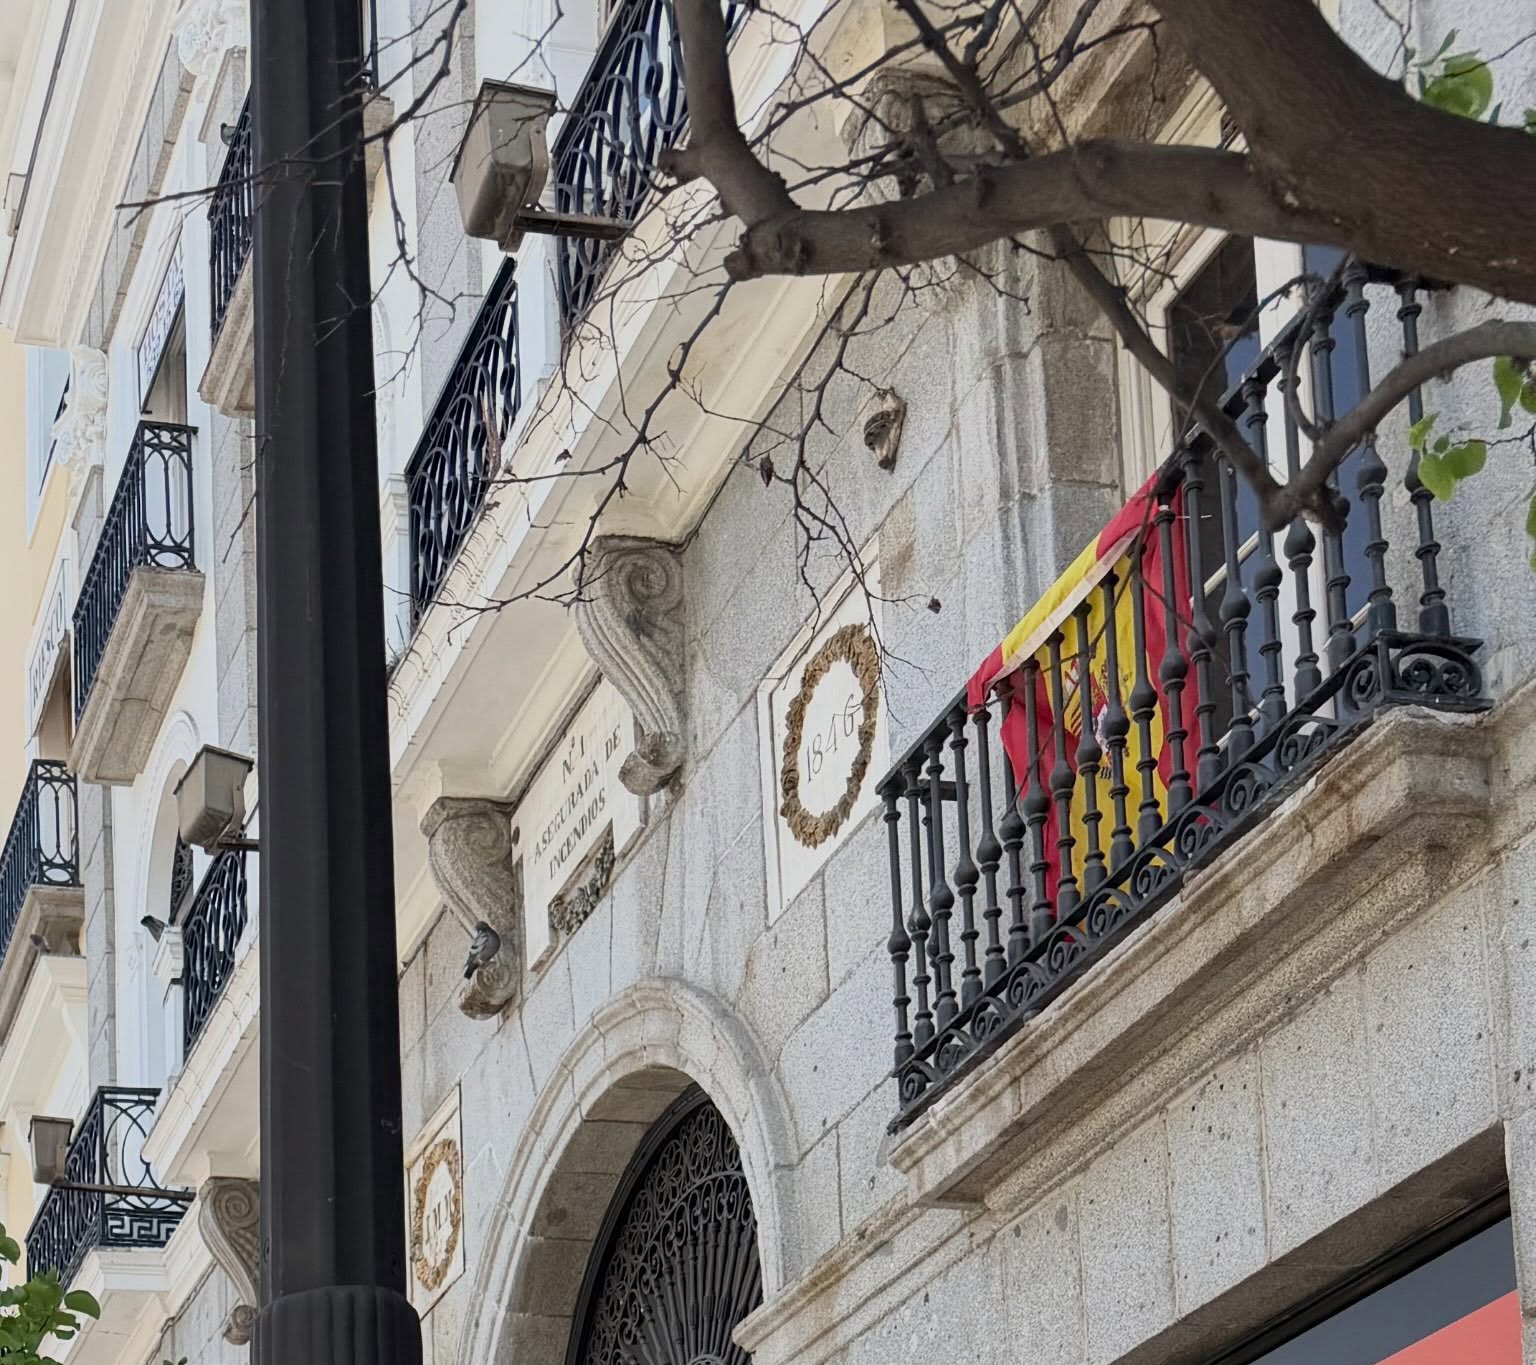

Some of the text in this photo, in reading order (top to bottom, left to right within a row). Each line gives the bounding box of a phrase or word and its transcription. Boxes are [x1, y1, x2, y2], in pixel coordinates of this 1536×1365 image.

[806, 693, 854, 785] 1846
[534, 724, 621, 864] ASEGURADA DE
[549, 787, 606, 880] INCENDIOS
